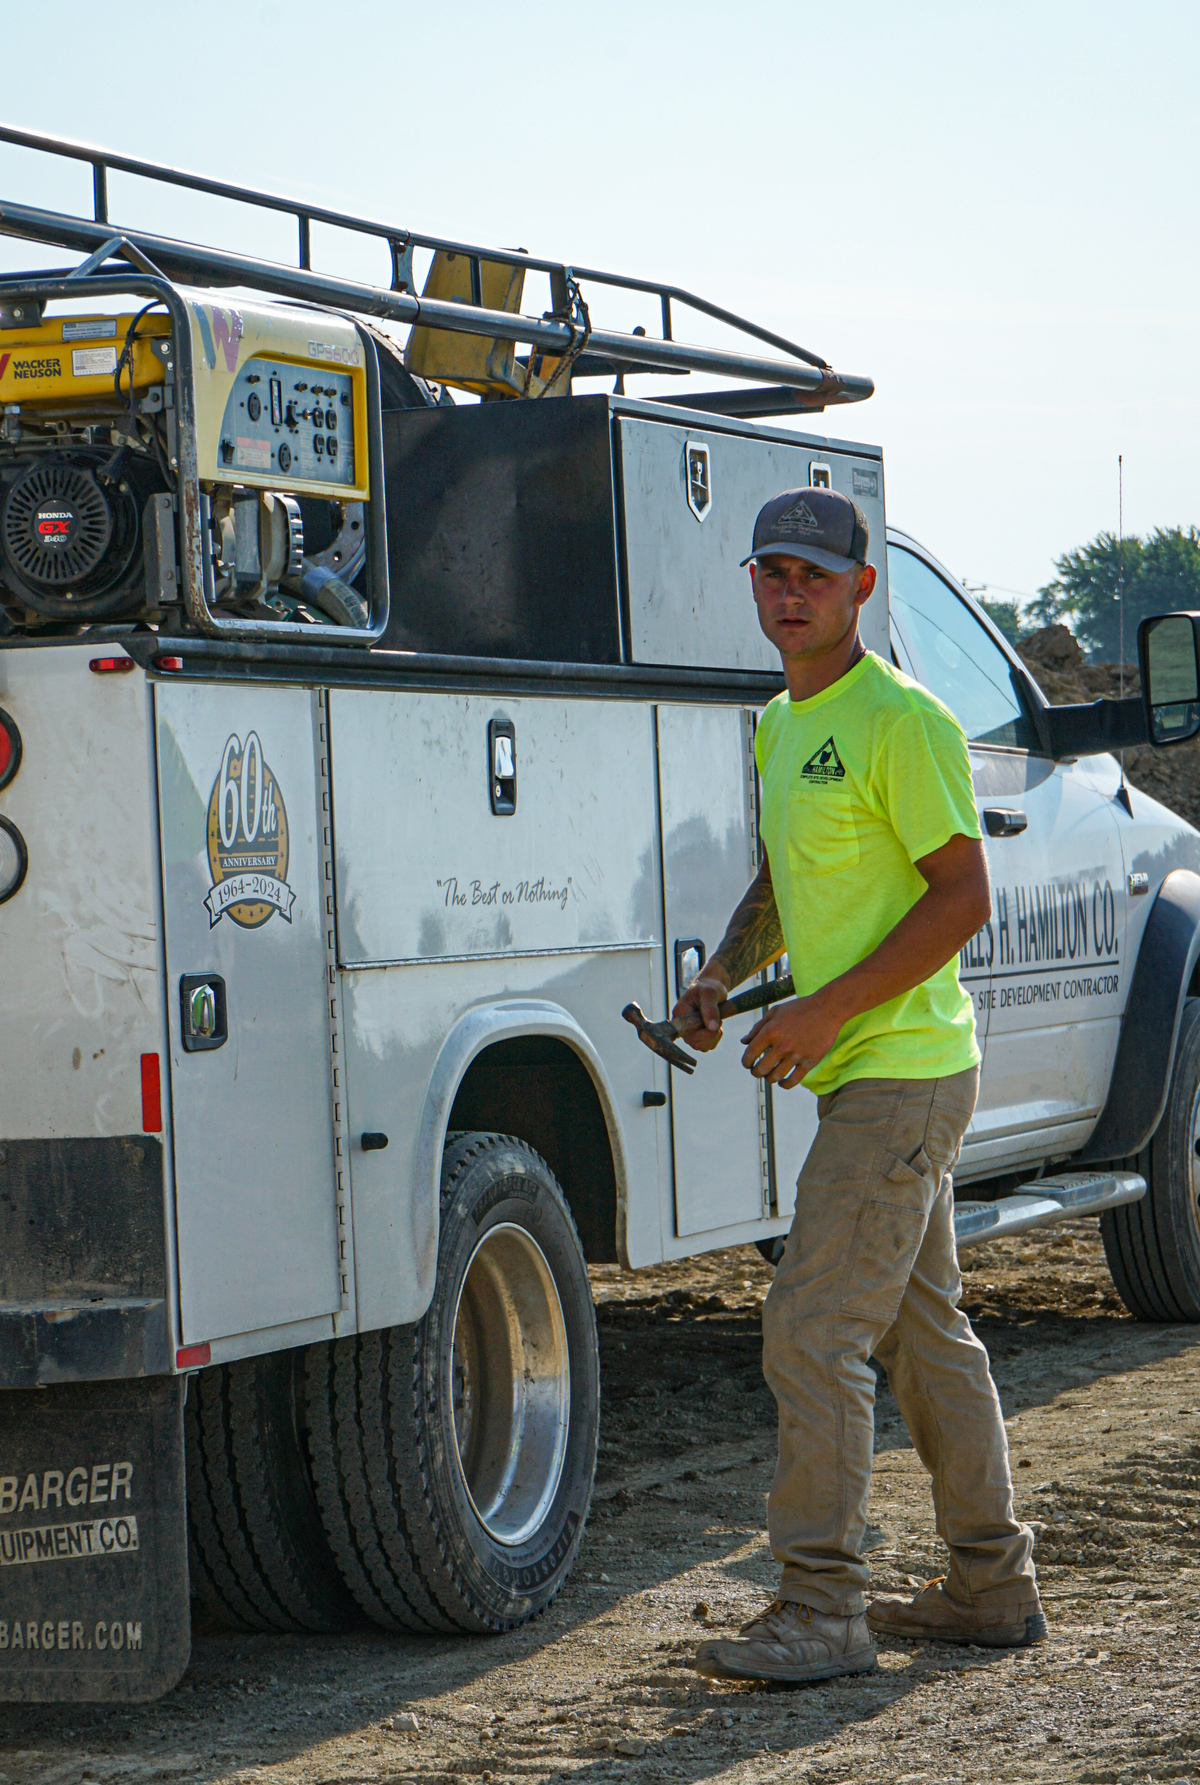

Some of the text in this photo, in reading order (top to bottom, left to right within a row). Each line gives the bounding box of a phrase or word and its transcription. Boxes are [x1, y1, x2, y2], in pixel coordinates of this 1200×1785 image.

[12, 358, 61, 370] WACKER
[14, 367, 61, 379] NEUSON
[38, 512, 74, 520] HONDA
[38, 521, 71, 534] GX
[218, 731, 277, 848] 60th
[222, 856, 276, 867] ANNIVERSARY
[217, 876, 281, 907] 1964-2024
[470, 879, 501, 906] Best
[996, 887, 1014, 966] H.
[1015, 882, 1088, 964] HAMILTON
[1093, 879, 1119, 957] CO.
[978, 989, 996, 1010] SITE
[1000, 981, 1061, 1008] DEVELOPMENT
[1063, 974, 1119, 1000] CONTRACTOR
[0, 1461, 133, 1514] BARGER
[0, 1523, 94, 1562] UIPMENT
[0, 1621, 143, 1650] BARGER.COM
